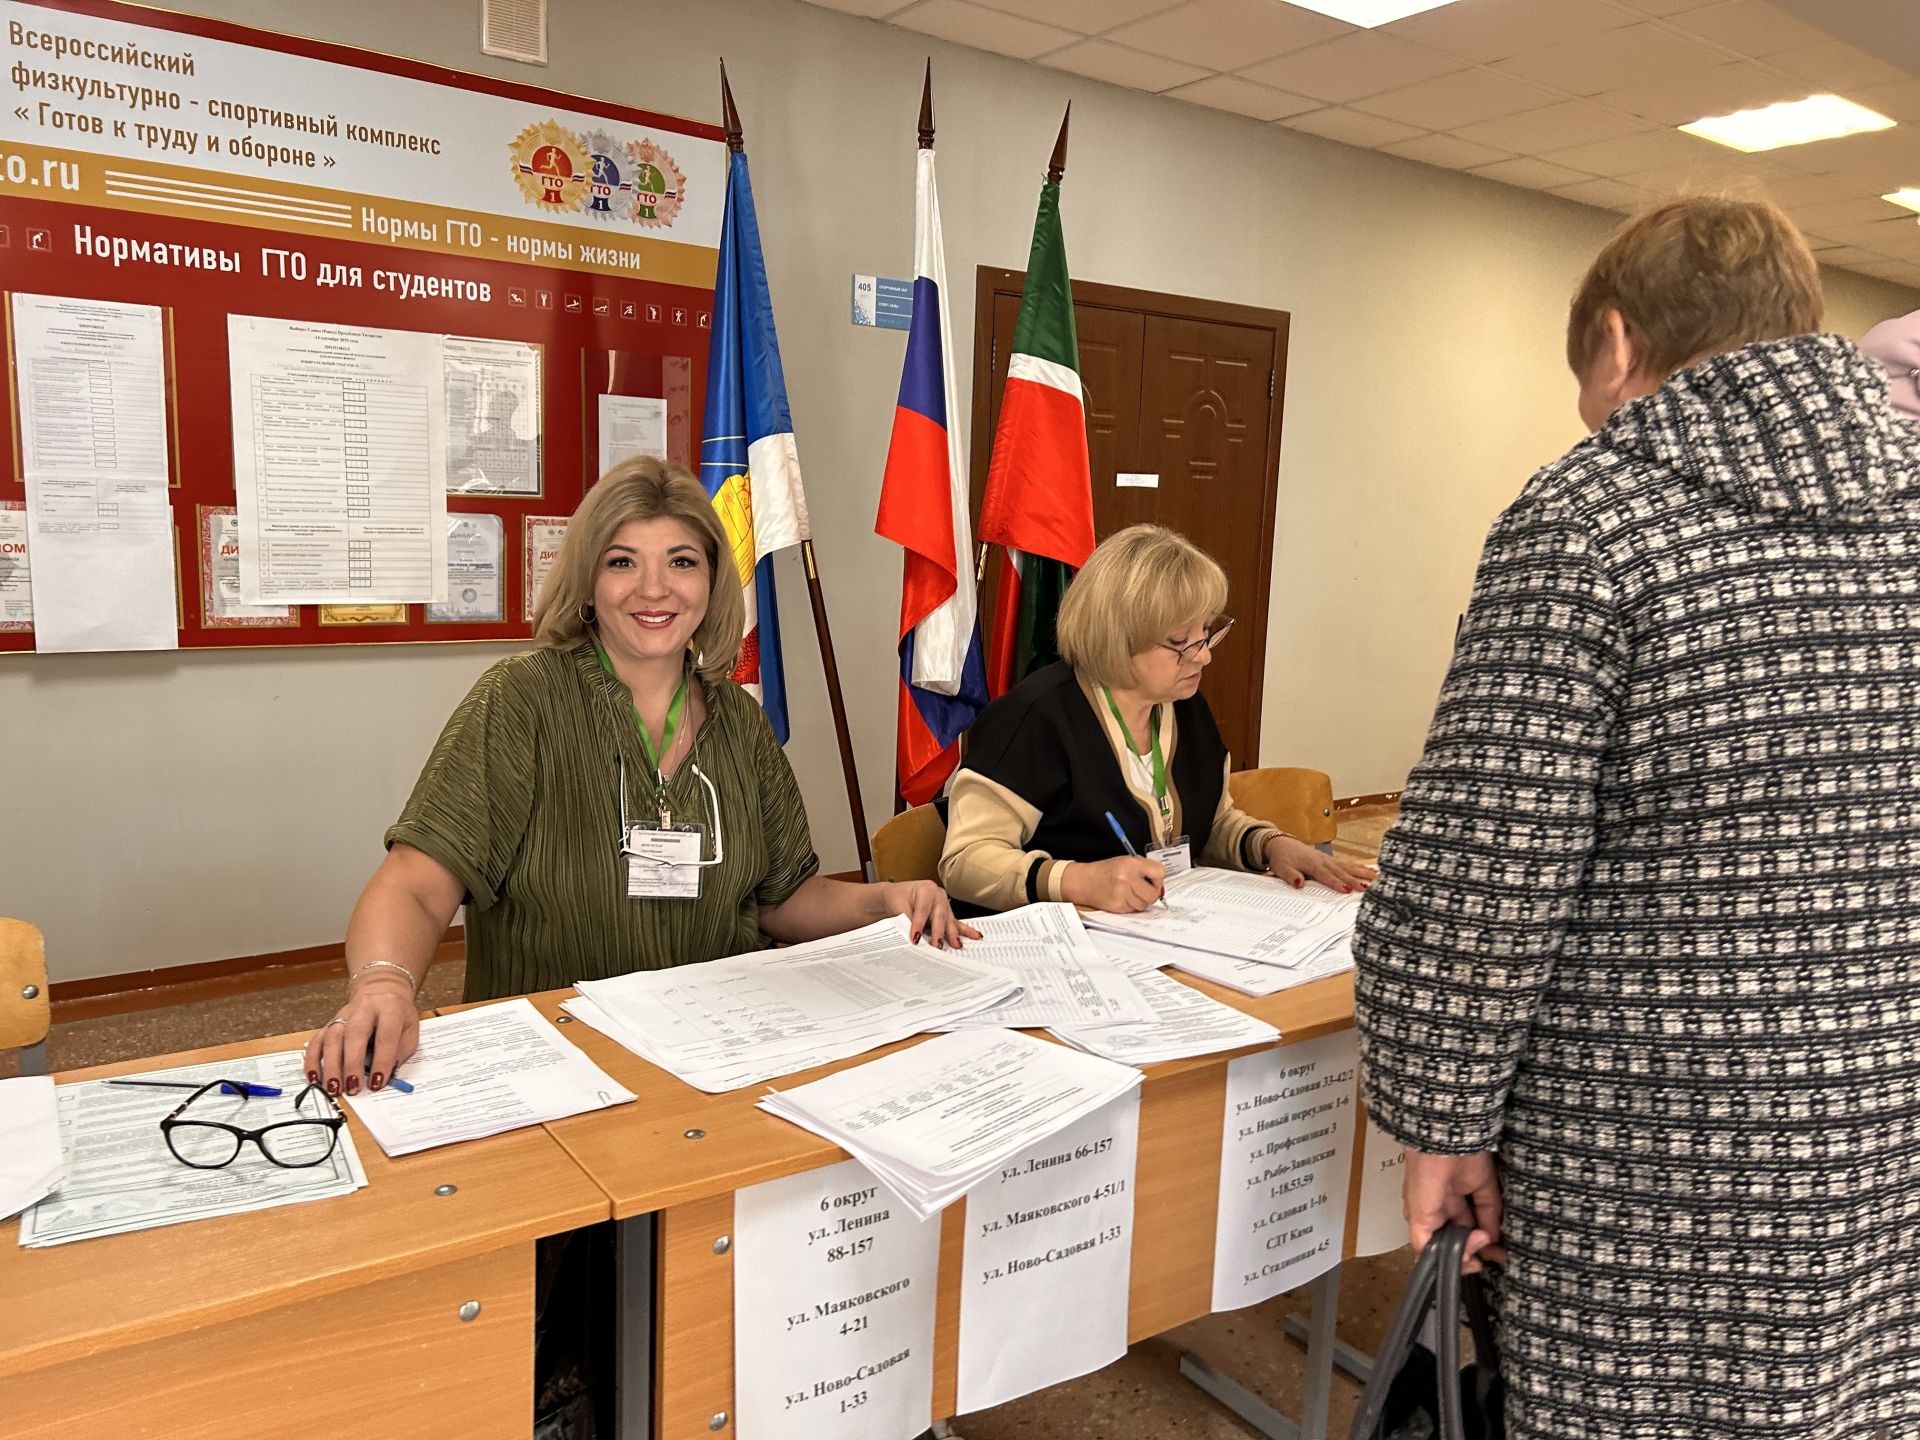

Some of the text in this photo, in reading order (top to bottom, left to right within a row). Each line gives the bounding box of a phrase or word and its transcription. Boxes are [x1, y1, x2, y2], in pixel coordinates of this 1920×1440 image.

[8, 20, 196, 77] Всероссийский
[11, 61, 181, 110] физкультурно
[208, 97, 339, 137] спортивный
[345, 124, 441, 155] комплекс
[39, 102, 103, 135] Готов
[113, 119, 126, 138] к
[135, 121, 198, 155] труду
[207, 135, 220, 153] и
[228, 136, 316, 168] обороне
[541, 176, 564, 188] ГТО
[590, 184, 611, 196] ГТО
[550, 192, 556, 202] 1
[597, 200, 604, 210] 1
[637, 193, 657, 204] ГТО
[644, 207, 650, 217] 1
[361, 206, 437, 243] Нормы
[446, 220, 482, 248] ГТО
[507, 233, 573, 261] нормы
[580, 244, 641, 270] жизни
[74, 225, 491, 303] Нормативы ГТО для студентов
[858, 282, 872, 292] 405
[1280, 1062, 1317, 1080] 6 округ
[1256, 1112, 1289, 1132] Новый
[1330, 1122, 1337, 1134] 3
[1001, 1137, 1113, 1183] ул. Ленина 66-157
[820, 1186, 878, 1211] 6 округ
[982, 1179, 1126, 1237] ул. Маяковского 4-51/1
[808, 1209, 891, 1245] ул. Ленина
[827, 1237, 874, 1262] 88-157
[982, 1225, 1121, 1284] ул. Ново-Садовая 1-33
[786, 1277, 910, 1330] ул. Маяковского
[839, 1315, 869, 1336] 4-21
[785, 1348, 911, 1409] ул. Ново-Садовая
[840, 1391, 868, 1414] 1-33
